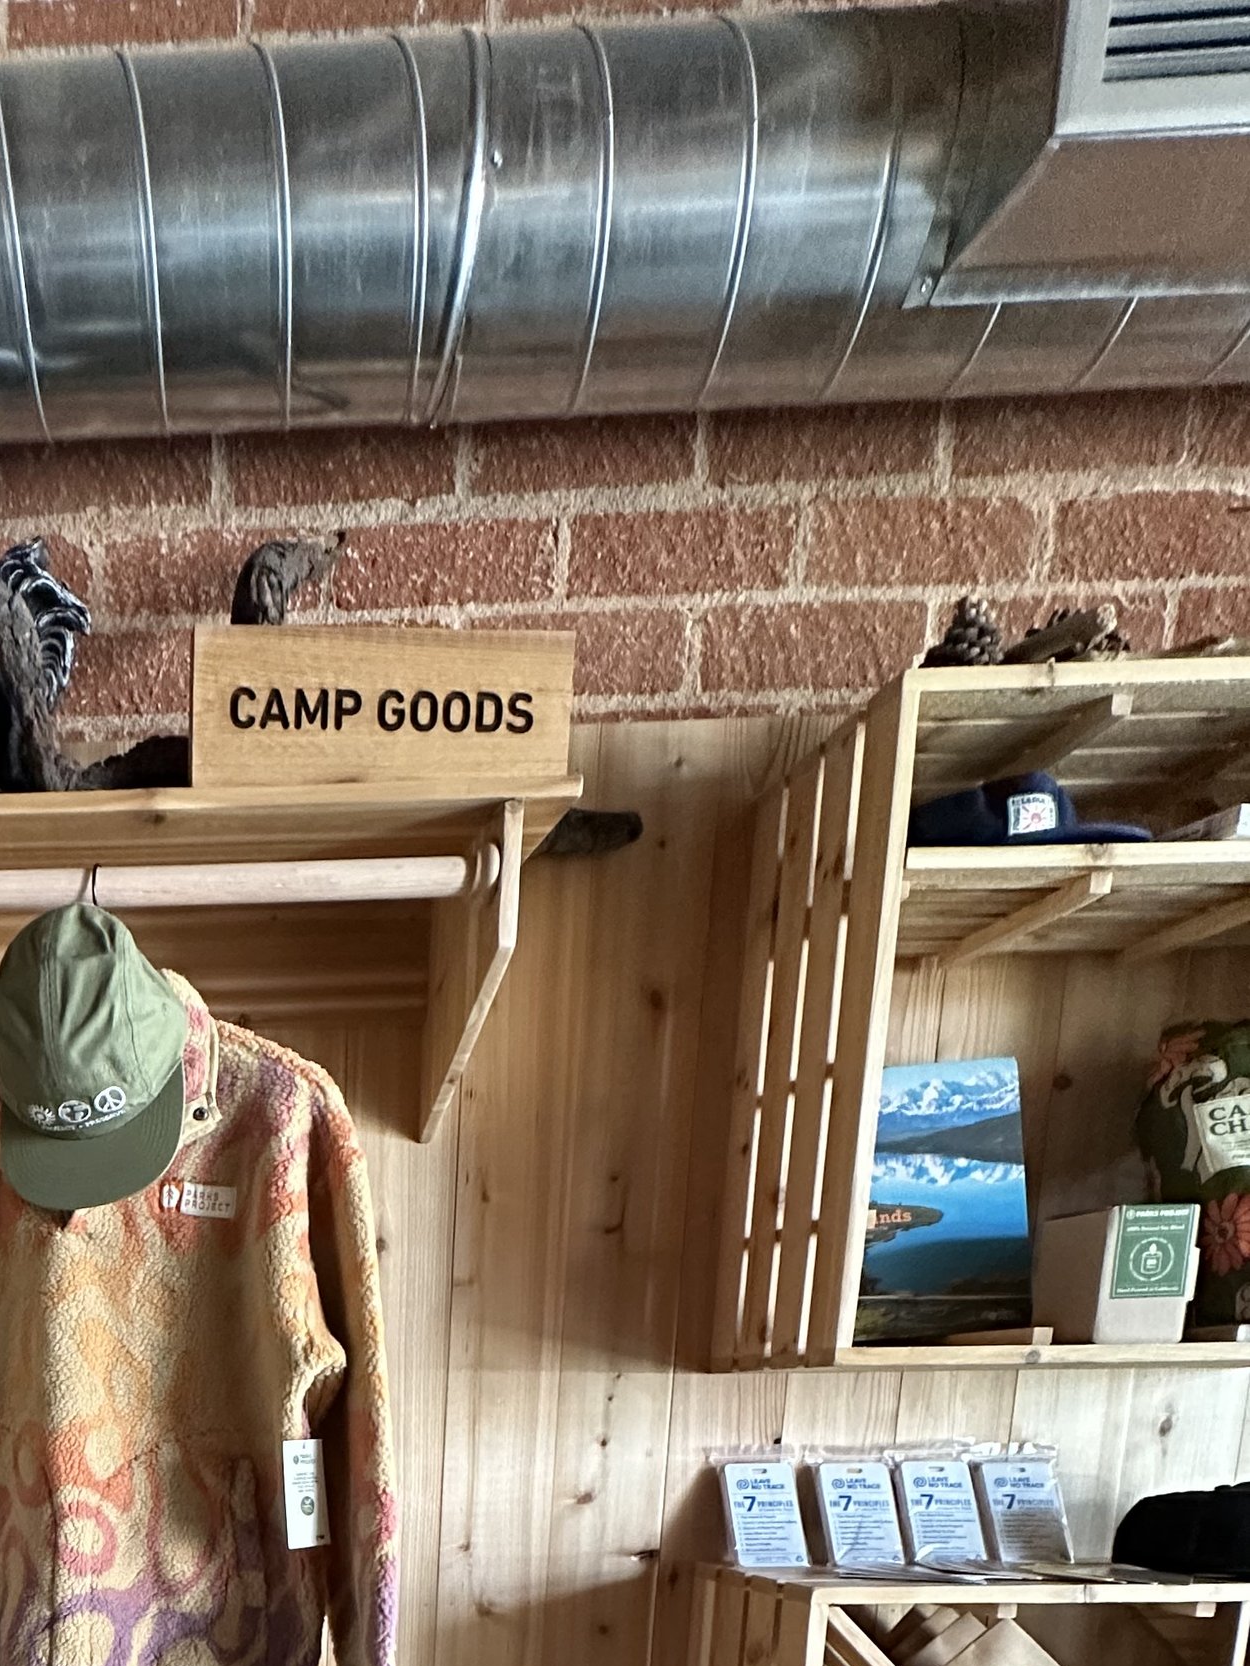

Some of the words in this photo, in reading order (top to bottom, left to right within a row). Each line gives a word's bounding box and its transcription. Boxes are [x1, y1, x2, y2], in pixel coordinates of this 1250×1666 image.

[229, 686, 362, 731] CAMP
[377, 689, 534, 734] GOODS
[1209, 1104, 1250, 1121] CA
[1210, 1118, 1250, 1136] CH
[186, 1190, 219, 1202] PARKS
[185, 1199, 231, 1213] PROJECT
[875, 1209, 912, 1224] nds
[743, 1495, 756, 1512] 7
[838, 1495, 852, 1511] 7
[920, 1493, 934, 1510] 7
[1002, 1494, 1016, 1509] 7
